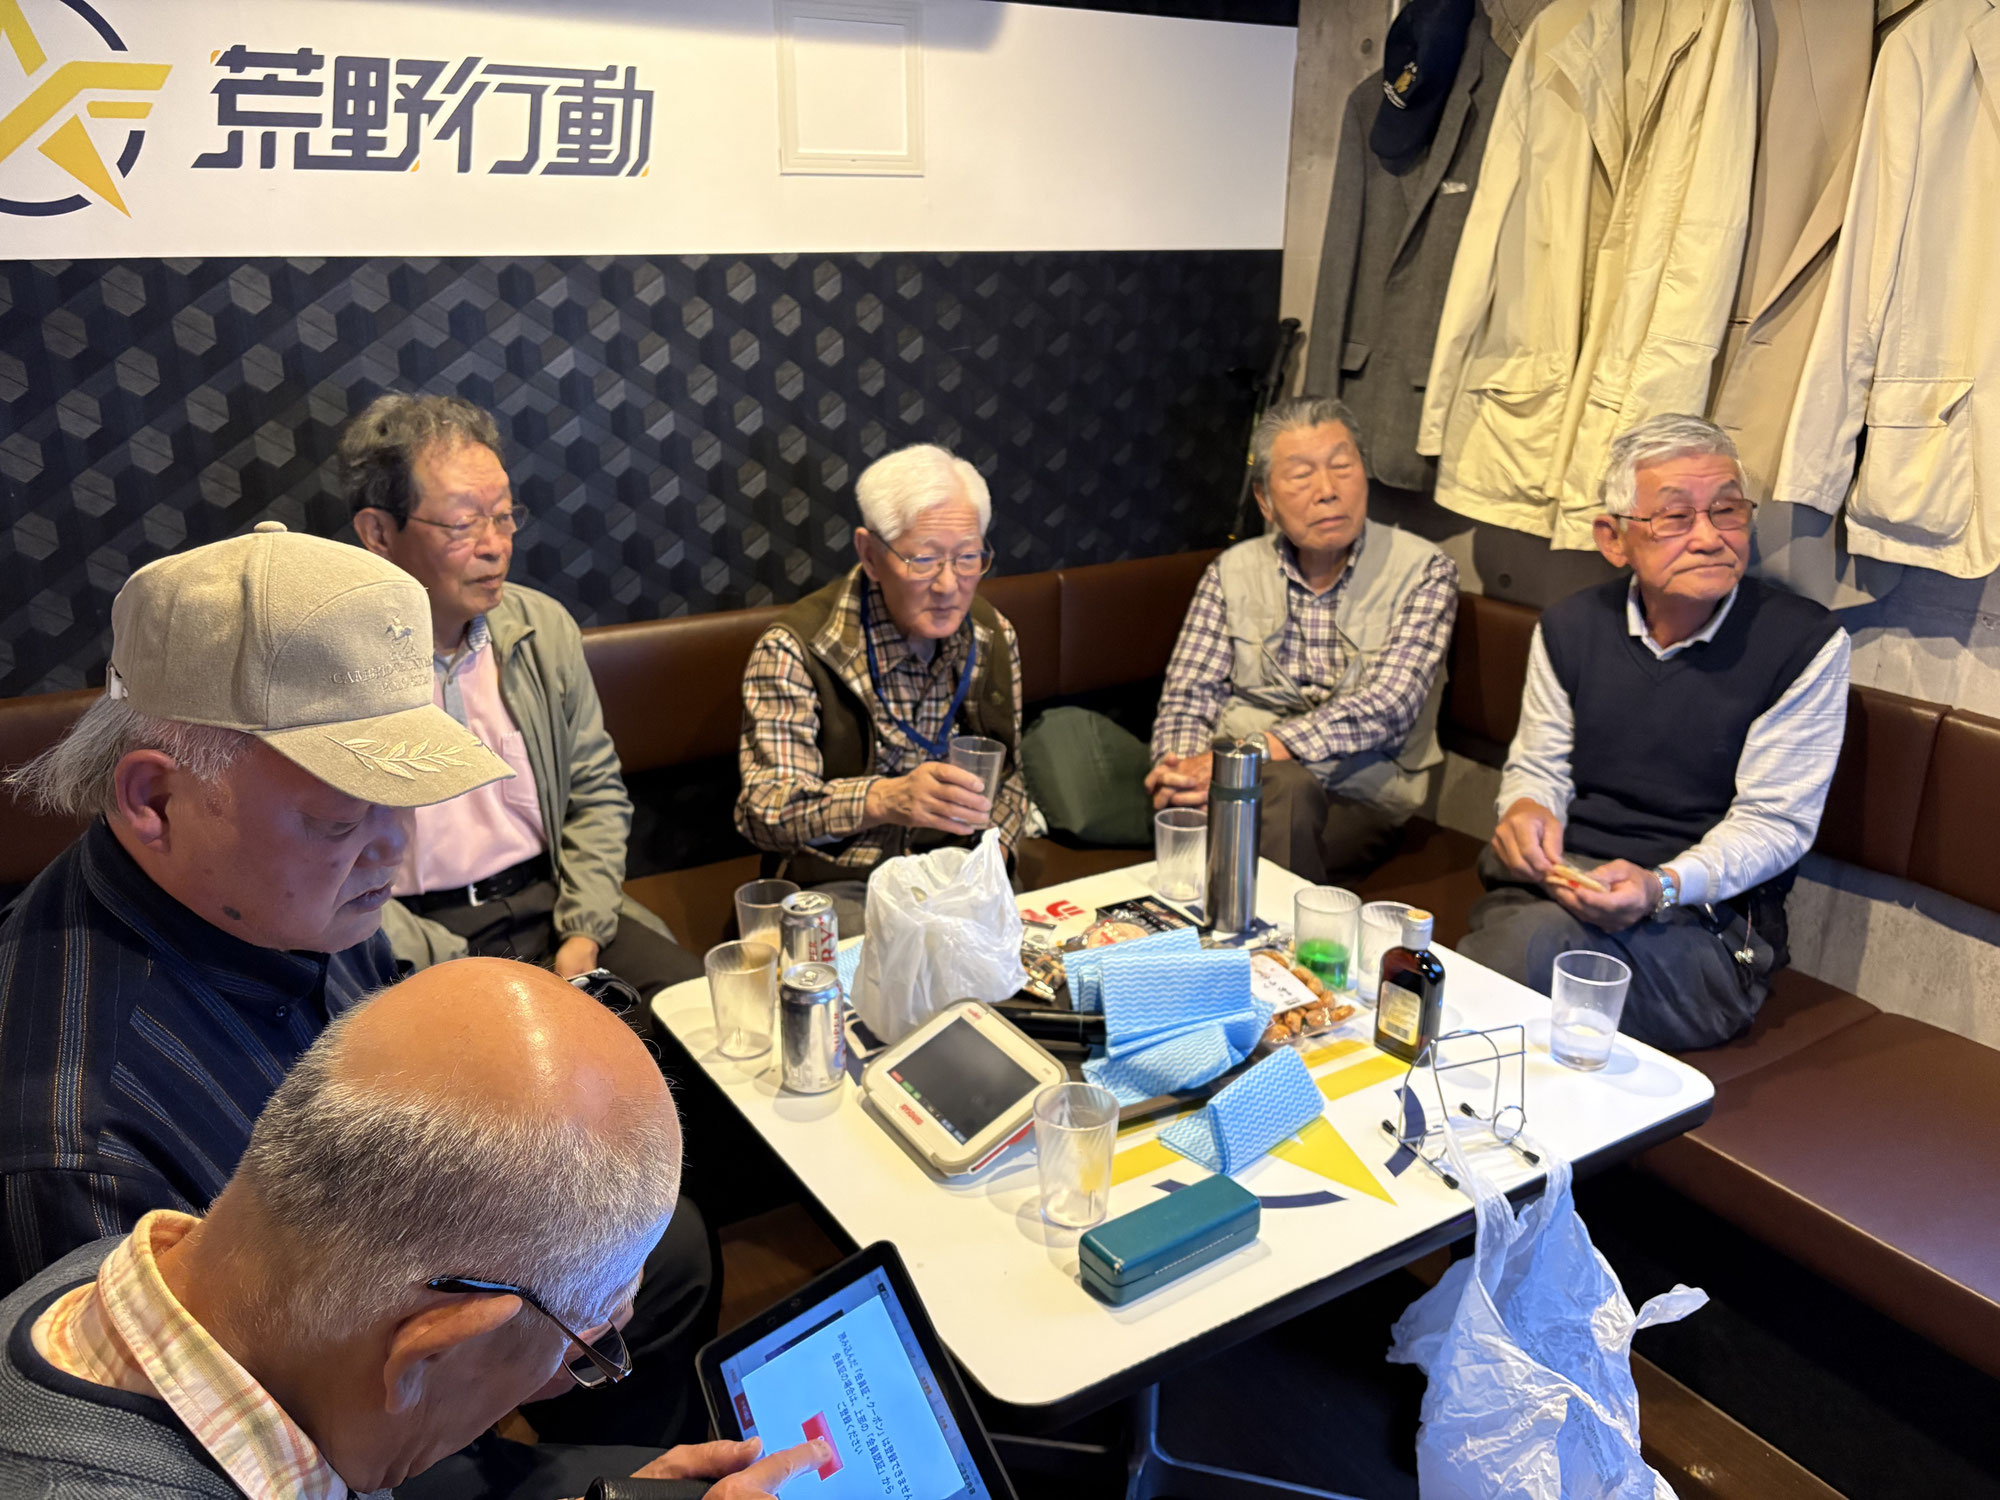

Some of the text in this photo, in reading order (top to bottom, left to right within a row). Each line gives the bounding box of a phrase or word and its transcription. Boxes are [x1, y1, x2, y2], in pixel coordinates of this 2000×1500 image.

[190, 45, 655, 177] 荒野行動
[821, 928, 836, 962] RY
